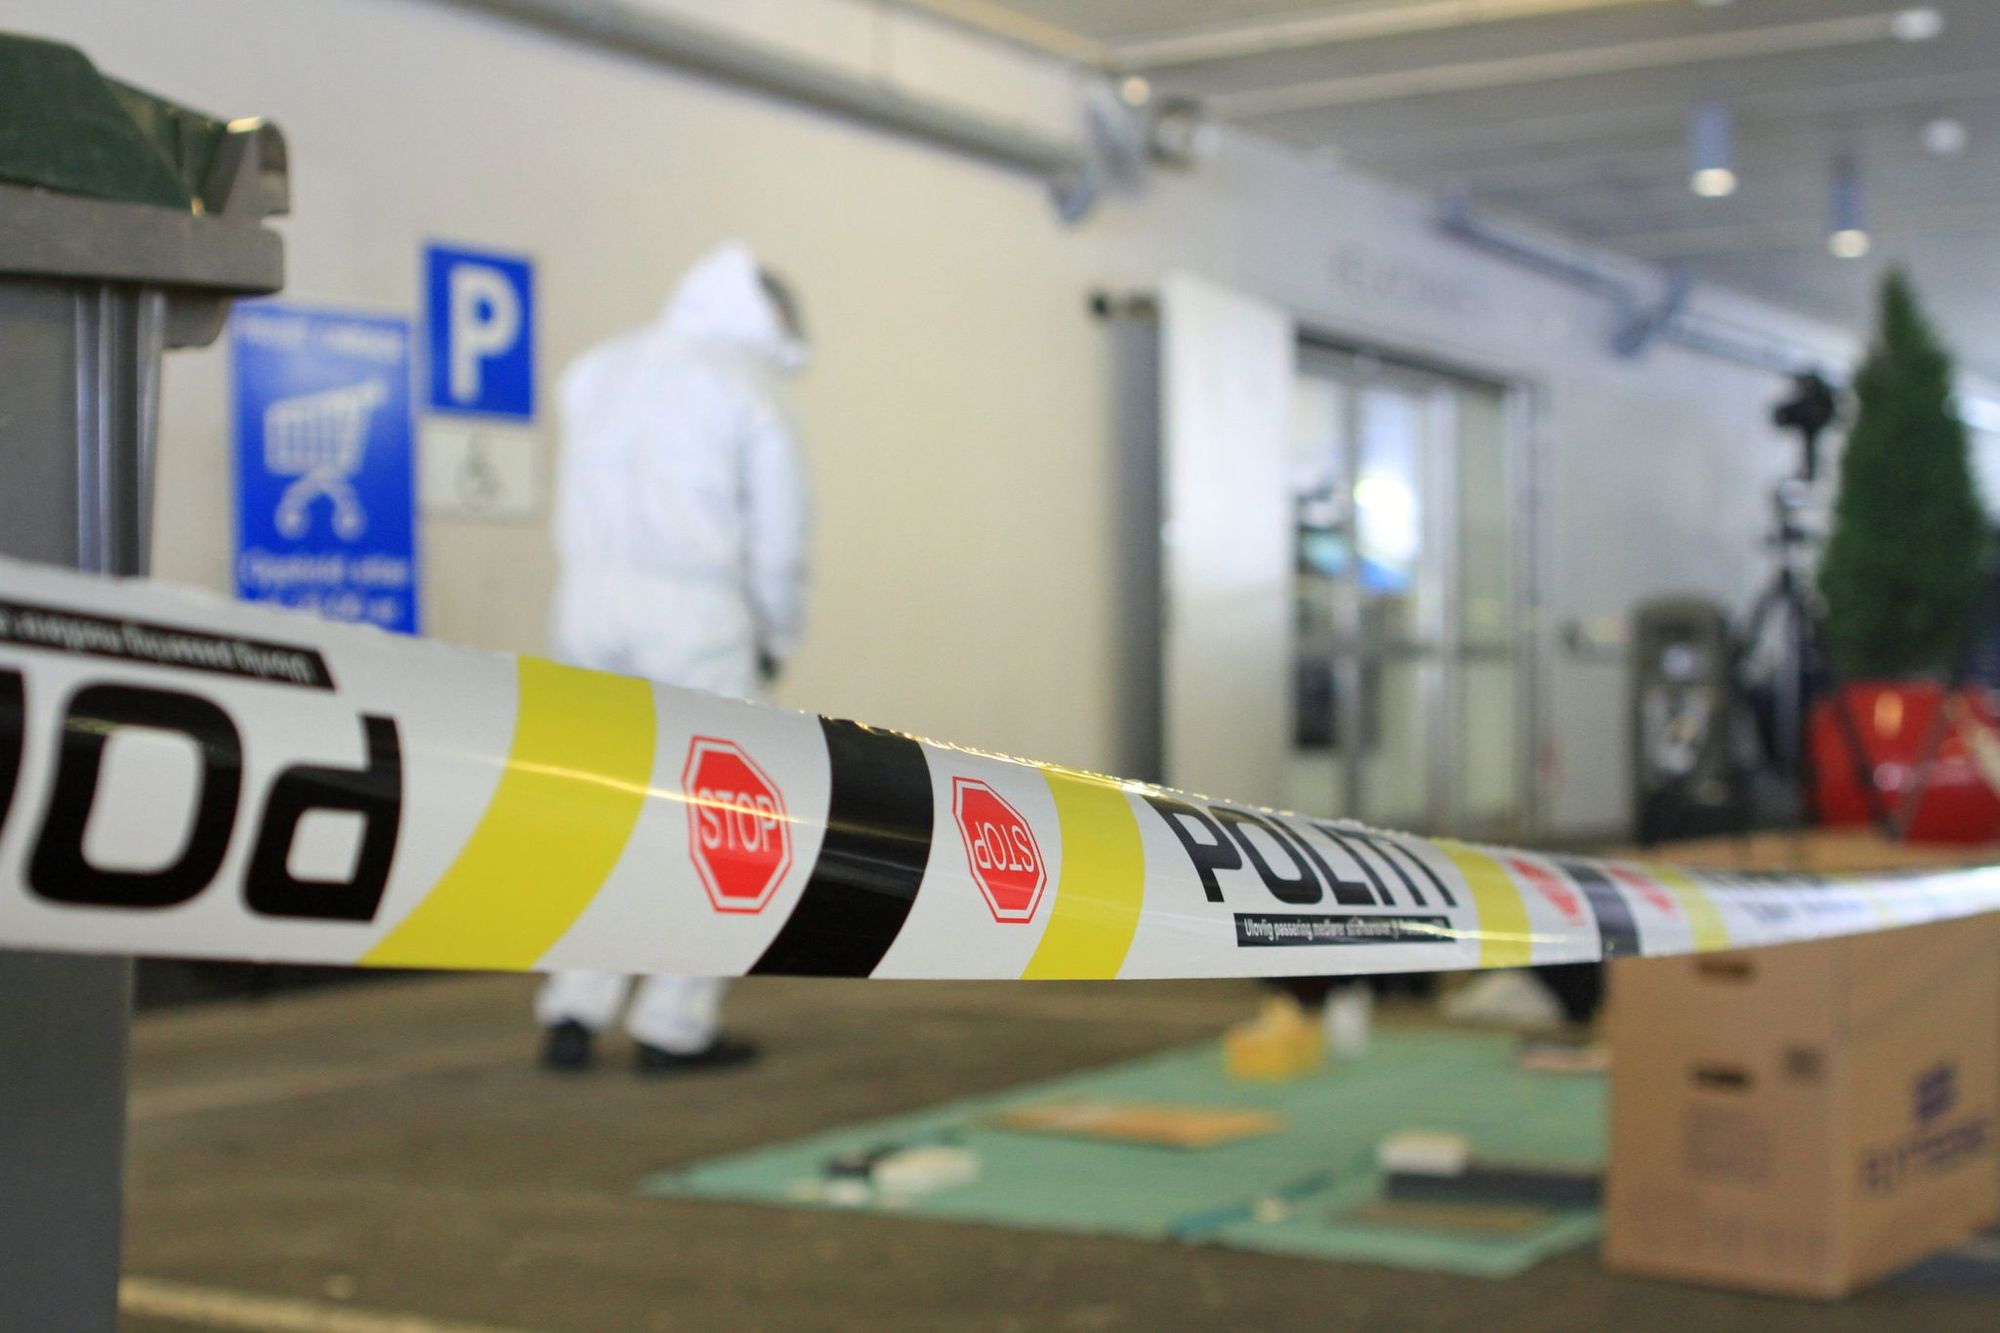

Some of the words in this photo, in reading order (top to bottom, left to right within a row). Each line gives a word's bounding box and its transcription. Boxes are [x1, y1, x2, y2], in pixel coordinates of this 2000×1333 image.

[450, 264, 520, 402] P
[0, 666, 402, 922] PO
[700, 789, 778, 852] STOP
[974, 820, 1034, 873] STOP
